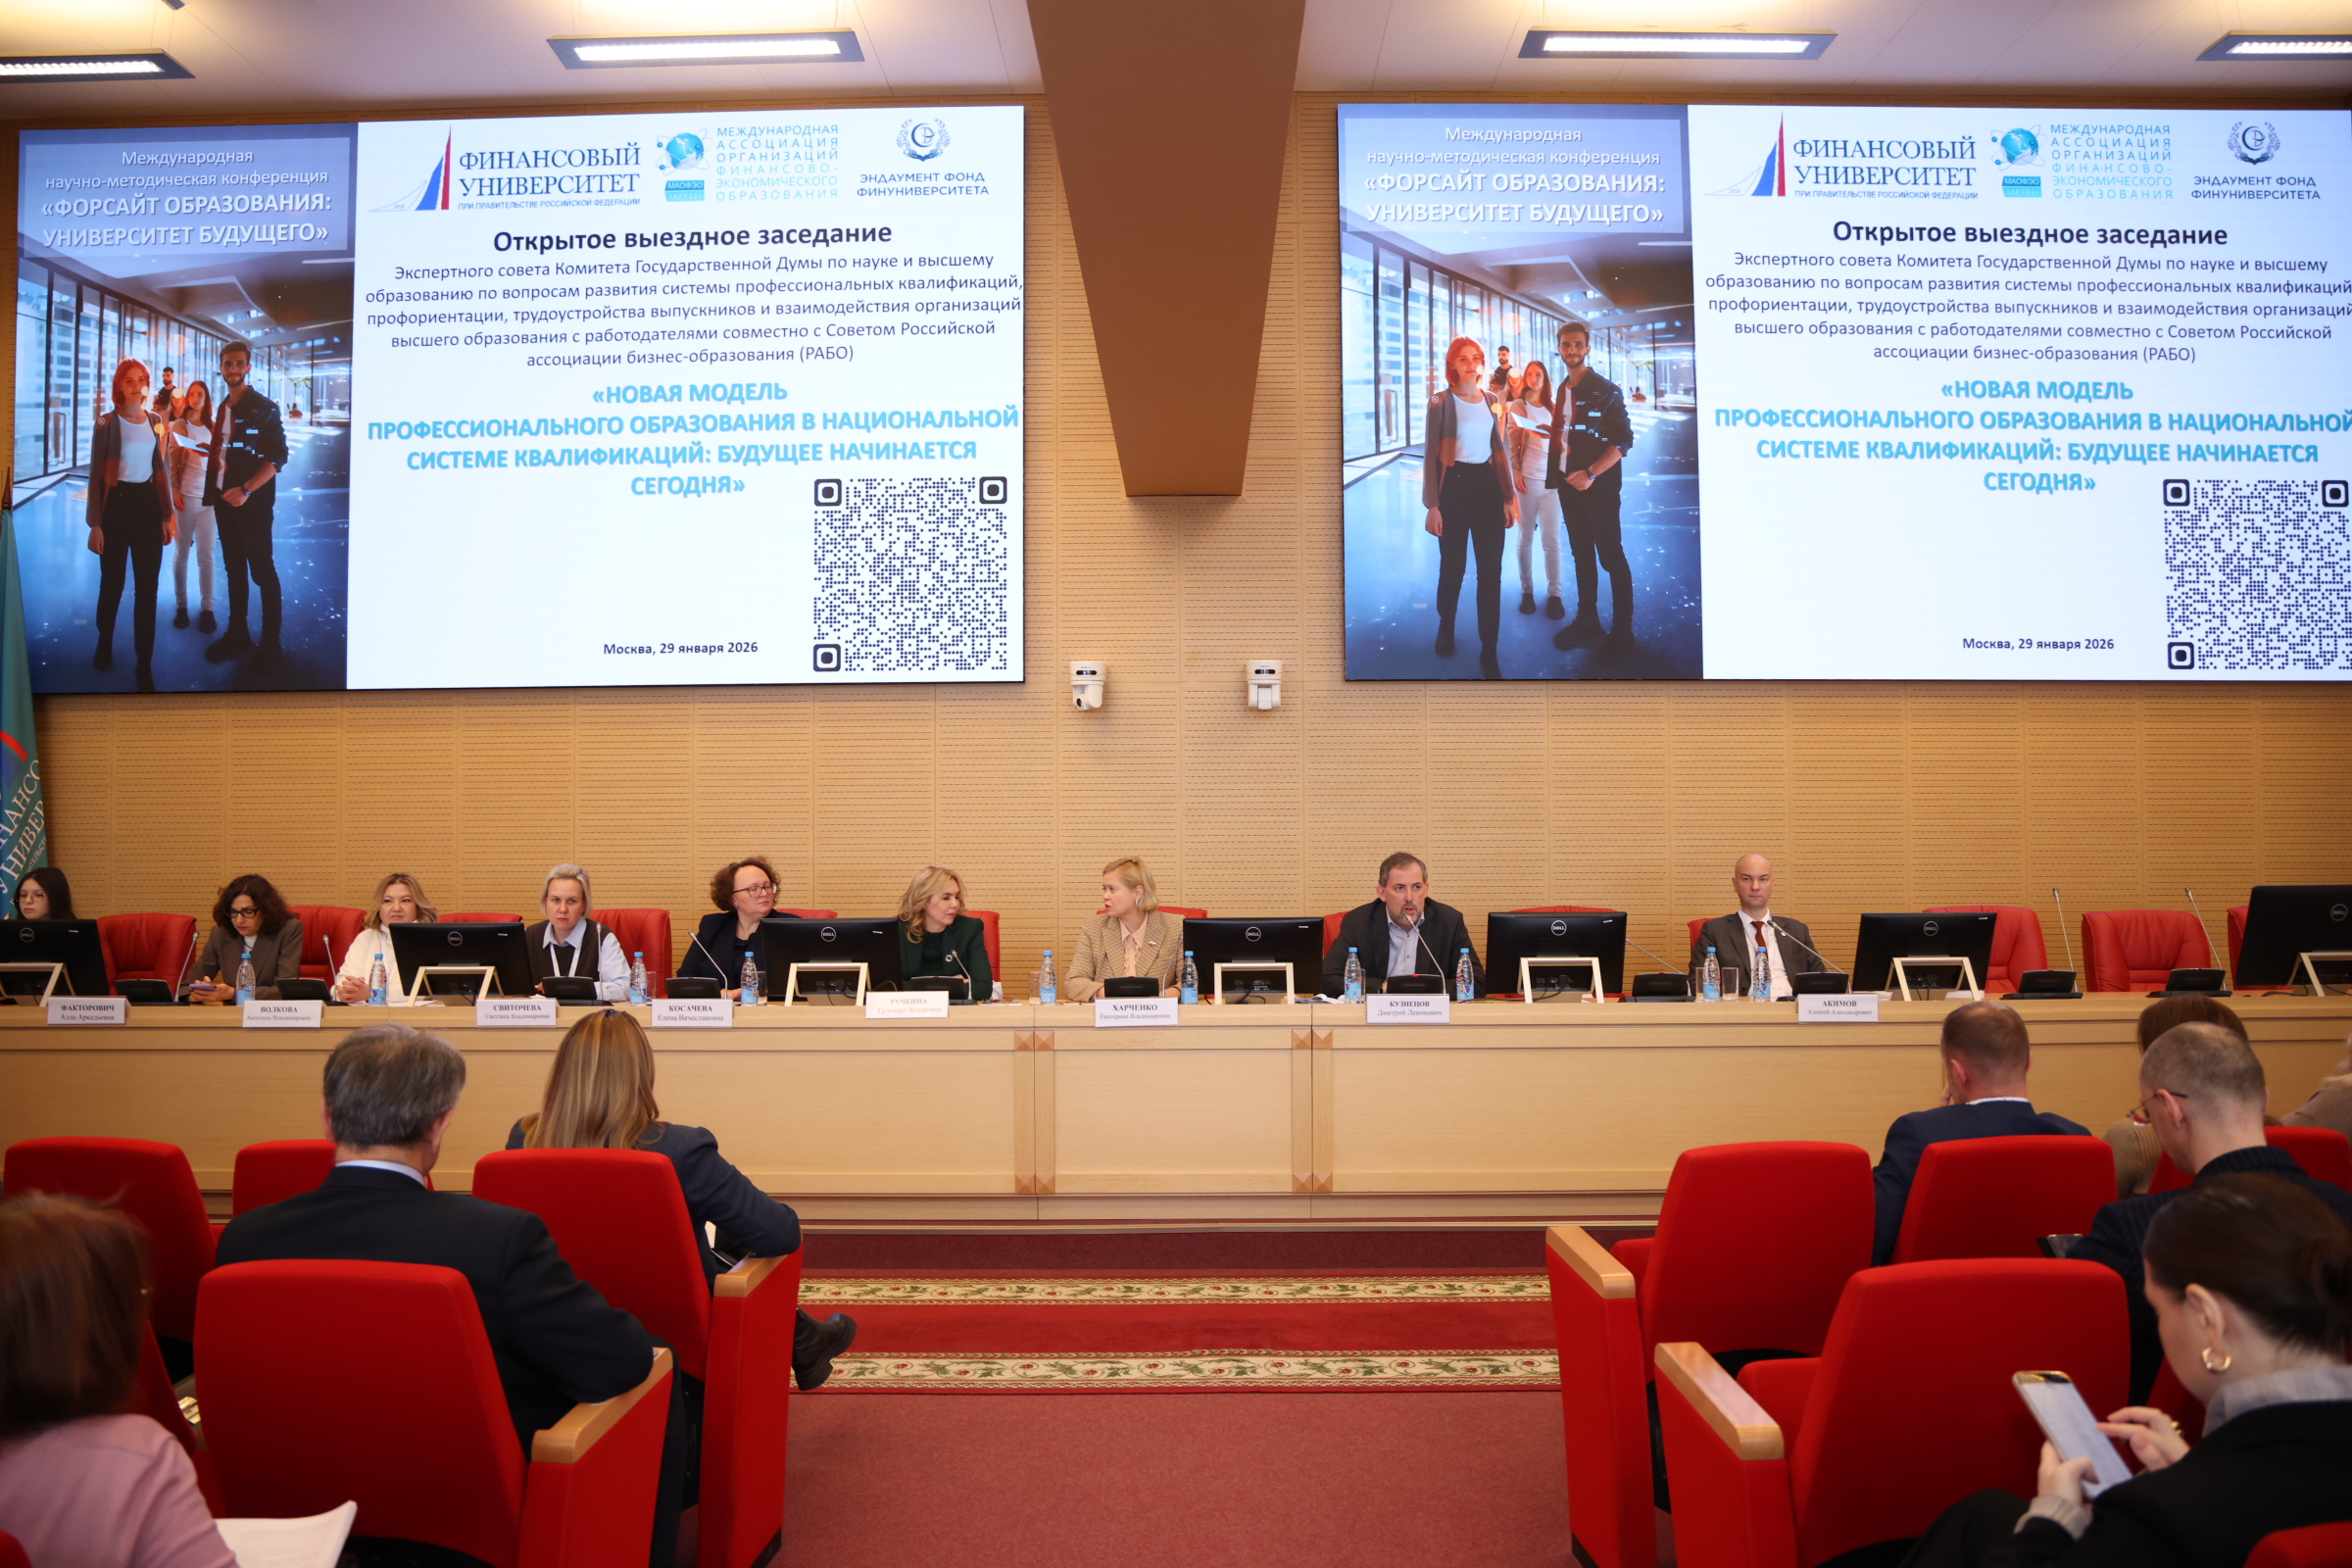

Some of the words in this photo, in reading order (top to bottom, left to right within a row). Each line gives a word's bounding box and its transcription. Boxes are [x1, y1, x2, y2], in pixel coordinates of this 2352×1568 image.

[716, 123, 839, 139] МЕЖДУНАРОДНАЯ
[1445, 126, 1582, 144] Международная
[2050, 123, 2171, 137] МЕЖДУНАРОДНАЯ
[715, 135, 839, 151] АССОЦИАЦИЯ
[1792, 134, 1977, 160] ФИНАНСОВЫЙ
[2050, 136, 2172, 151] АССОЦИАЦИЯ
[122, 151, 253, 168] Международная
[459, 141, 642, 171] ФИНАНСОВЫЙ
[716, 146, 838, 164] ОРГАНИЗАЦИЙ
[1367, 151, 1544, 169] научно-методическая
[1549, 149, 1660, 167] конференция
[2051, 145, 2172, 164] ОРГАНИЗАЦИЙ
[715, 160, 839, 176] ФИНАНСОВО-
[1793, 165, 1977, 186] УНИВЕРСИТЕТ
[2051, 161, 2173, 174] ФИНАНСОВО-
[45, 174, 217, 191] научно-методическая
[221, 170, 328, 187] конференция
[458, 172, 641, 198] УНИВЕРСИТЕТ
[715, 174, 838, 189] ЭКОНОМИЧЕСКОГО
[859, 172, 941, 185] ЭНДАУМЕНТ
[944, 172, 986, 183] ФОНД
[1363, 168, 1487, 191] «ФОРСАЙТ
[1492, 172, 1665, 192] ОБРАЗОВАНИЯ:
[2052, 174, 2173, 187] ЭКОНОМИЧЕСКОГО
[2193, 175, 2273, 187] ЭНДАУМЕНТ
[2276, 175, 2317, 188] ФОНД
[715, 188, 838, 202] ОБРАЗОВАНИЯ
[856, 185, 990, 197] ФИНУНИВЕРСИТЕТА
[2052, 187, 2174, 200] ОБРАЗОВАНИЯ
[2190, 189, 2322, 200] ФИНУНИВЕРСИТЕТА
[41, 192, 160, 219] «ФОРСАЙТ
[164, 192, 331, 214] ОБРАЗОВАНИЯ:
[458, 202, 474, 211] ПРИ
[475, 200, 539, 210] ПРАВИТЕЛЬСТВЕ
[539, 198, 593, 208] РОССИЙСКОЙ
[593, 198, 641, 208] ФЕДЕРАЦИИ
[1365, 203, 1524, 226] УНИВЕРСИТЕТ
[1529, 203, 1663, 227] БУДУЩЕГО»
[41, 225, 194, 249] УНИВЕРСИТЕТ
[199, 222, 328, 247] БУДУЩЕГО»
[493, 230, 616, 256] Открытое
[624, 229, 751, 252] выездное
[758, 226, 893, 249] заседание
[1833, 220, 1957, 247] Открытое
[1964, 226, 2089, 248] выездное
[2096, 227, 2229, 249] заседание
[394, 266, 494, 282] Экспертного
[498, 265, 551, 277] совета
[555, 262, 630, 275] Комитета
[635, 256, 772, 276] Государственной
[775, 256, 822, 273] Думы
[852, 257, 899, 271] науке
[918, 255, 995, 270] высшему
[1734, 251, 1836, 270] Экспертного
[1838, 256, 1892, 268] совета
[1896, 253, 1973, 269] Комитета
[1977, 254, 2112, 272] Государственной
[2115, 256, 2162, 273] Думы
[2189, 260, 2235, 273] науке
[2254, 260, 2328, 274] высшему
[366, 288, 474, 306] образованию
[502, 286, 580, 302] вопросам
[585, 284, 658, 301] развития
[662, 282, 731, 295] системы
[735, 278, 895, 297] профессиональных
[899, 273, 1023, 292] квалификаций,
[1705, 273, 1816, 291] образованию
[1844, 278, 1924, 293] вопросам
[1928, 279, 2000, 293] развития
[2004, 280, 2073, 292] системы
[2077, 277, 2232, 295] профессиональных
[367, 310, 509, 328] профориентации,
[513, 305, 646, 324] трудоустройства
[651, 305, 757, 320] выпускников
[775, 299, 910, 318] взаимодействия
[914, 296, 1021, 316] организаций
[1708, 296, 1853, 315] профориентации,
[1856, 298, 1989, 316] трудоустройства
[1994, 302, 2099, 318] выпускников
[2117, 301, 2248, 318] взаимодействия
[391, 335, 460, 348] высшего
[464, 331, 567, 349] образования
[584, 327, 718, 346] работодателями
[722, 326, 809, 340] совместно
[825, 322, 896, 337] Советом
[901, 319, 996, 336] Российской
[1735, 322, 1804, 335] высшего
[1808, 320, 1913, 338] образования
[1930, 321, 2063, 340] работодателями
[2067, 326, 2151, 338] совместно
[2167, 324, 2236, 339] Советом
[2240, 324, 2332, 340] Российской
[526, 354, 622, 368] ассоциации
[626, 348, 795, 366] бизнес-образования
[799, 344, 854, 364] (РАБО)
[1873, 347, 1969, 362] ассоциации
[1973, 344, 2138, 364] бизнес-образования
[2142, 346, 2196, 365] (РАБО)
[592, 384, 683, 405] «НОВАЯ
[689, 382, 788, 406] МОДЕЛЬ
[1940, 379, 2031, 400] «НОВАЯ
[2036, 380, 2134, 404] МОДЕЛЬ
[368, 416, 624, 441] ПРОФЕССИОНАЛЬНОГО
[629, 413, 796, 435] ОБРАЗОВАНИЯ
[822, 404, 1019, 434] НАЦИОНАЛЬНОЙ
[1714, 408, 1975, 430] ПРОФЕССИОНАЛЬНОГО
[1979, 410, 2142, 431] ОБРАЗОВАНИЯ
[406, 449, 509, 471] СИСТЕМЕ
[514, 440, 711, 468] КВАЛИФИКАЦИЙ:
[717, 443, 824, 467] БУДУЩЕЕ
[829, 440, 977, 462] НАЧИНАЕТСЯ
[1756, 439, 1861, 460] СИСТЕМЕ
[1866, 437, 2062, 466] КВАЛИФИКАЦИЙ:
[2067, 442, 2172, 466] БУДУЩЕЕ
[2176, 443, 2319, 464] НАЧИНАЕТСЯ
[630, 474, 746, 499] СЕГОДНЯ»
[1983, 471, 2097, 496] СЕГОДНЯ»
[603, 643, 657, 657] Москва,
[677, 644, 724, 657] января
[727, 641, 759, 654] 2026
[1962, 637, 2015, 652] Москва,
[2035, 640, 2082, 653] января
[2083, 638, 2115, 650] 2026
